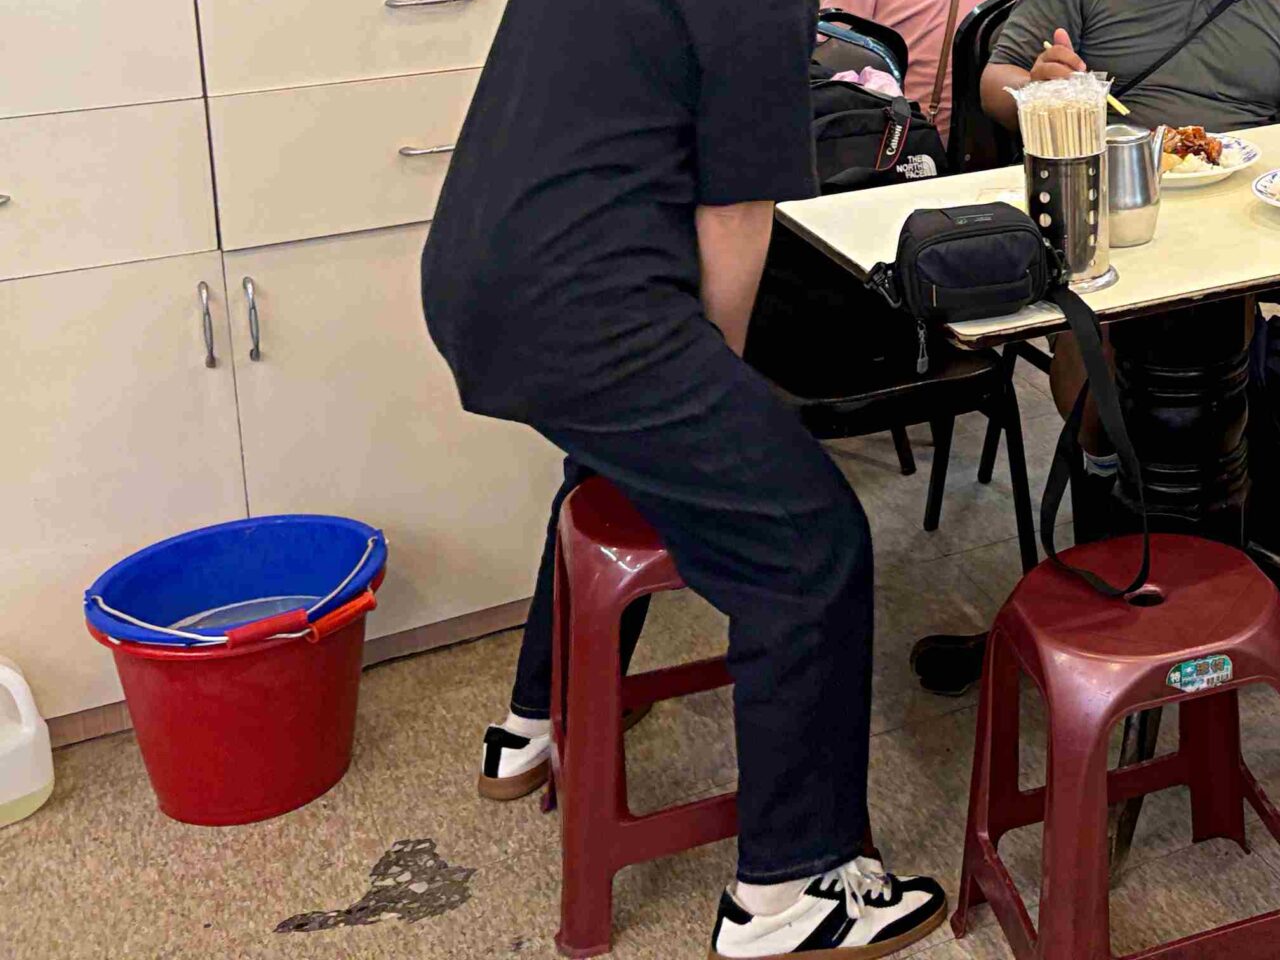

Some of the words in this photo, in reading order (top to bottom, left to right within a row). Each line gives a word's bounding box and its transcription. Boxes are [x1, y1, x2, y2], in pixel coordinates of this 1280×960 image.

[886, 125, 903, 155] Canon
[907, 155, 923, 164] THE
[896, 162, 924, 173] NORTH
